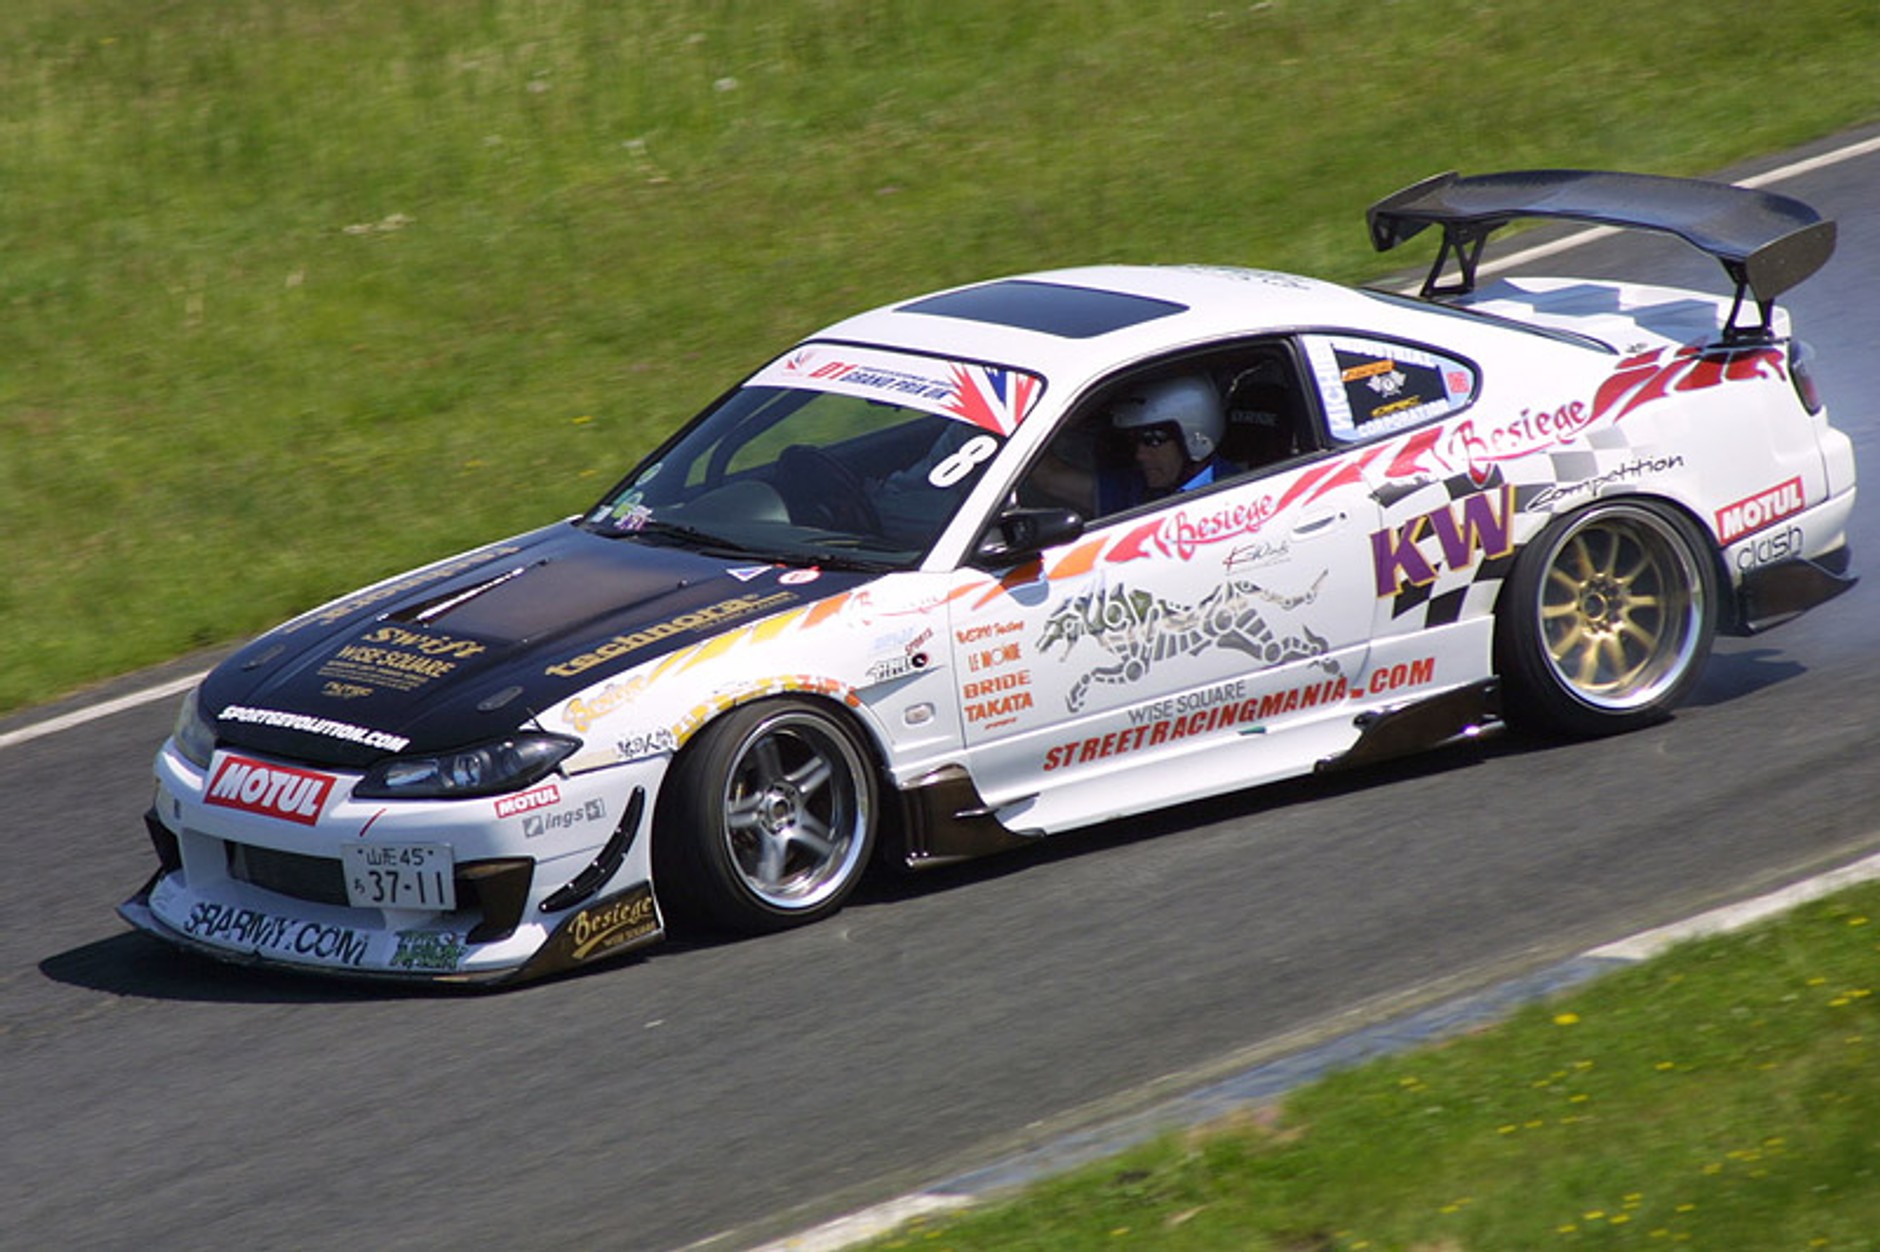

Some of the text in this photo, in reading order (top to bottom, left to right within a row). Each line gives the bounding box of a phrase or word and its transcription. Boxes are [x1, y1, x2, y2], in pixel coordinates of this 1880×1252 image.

[808, 362, 859, 380] D1
[840, 371, 896, 388] GRAND
[888, 380, 930, 396] PRIX
[928, 435, 998, 487] 8
[1448, 400, 1586, 487] Besiege
[1526, 454, 1685, 512] Competition
[1164, 494, 1273, 561] Besiege
[1721, 482, 1803, 541] MOTUL
[1370, 484, 1515, 598] KW
[545, 598, 754, 677] technora
[963, 669, 1031, 699] BRIDE
[963, 690, 1034, 723] TAKATA
[1128, 679, 1247, 727] WISE SQUARE
[1042, 656, 1435, 773] STREETRACINGMANIA.COM
[211, 762, 325, 817] MOTUL
[498, 789, 560, 816] MOTUL
[567, 896, 653, 947] Besiege
